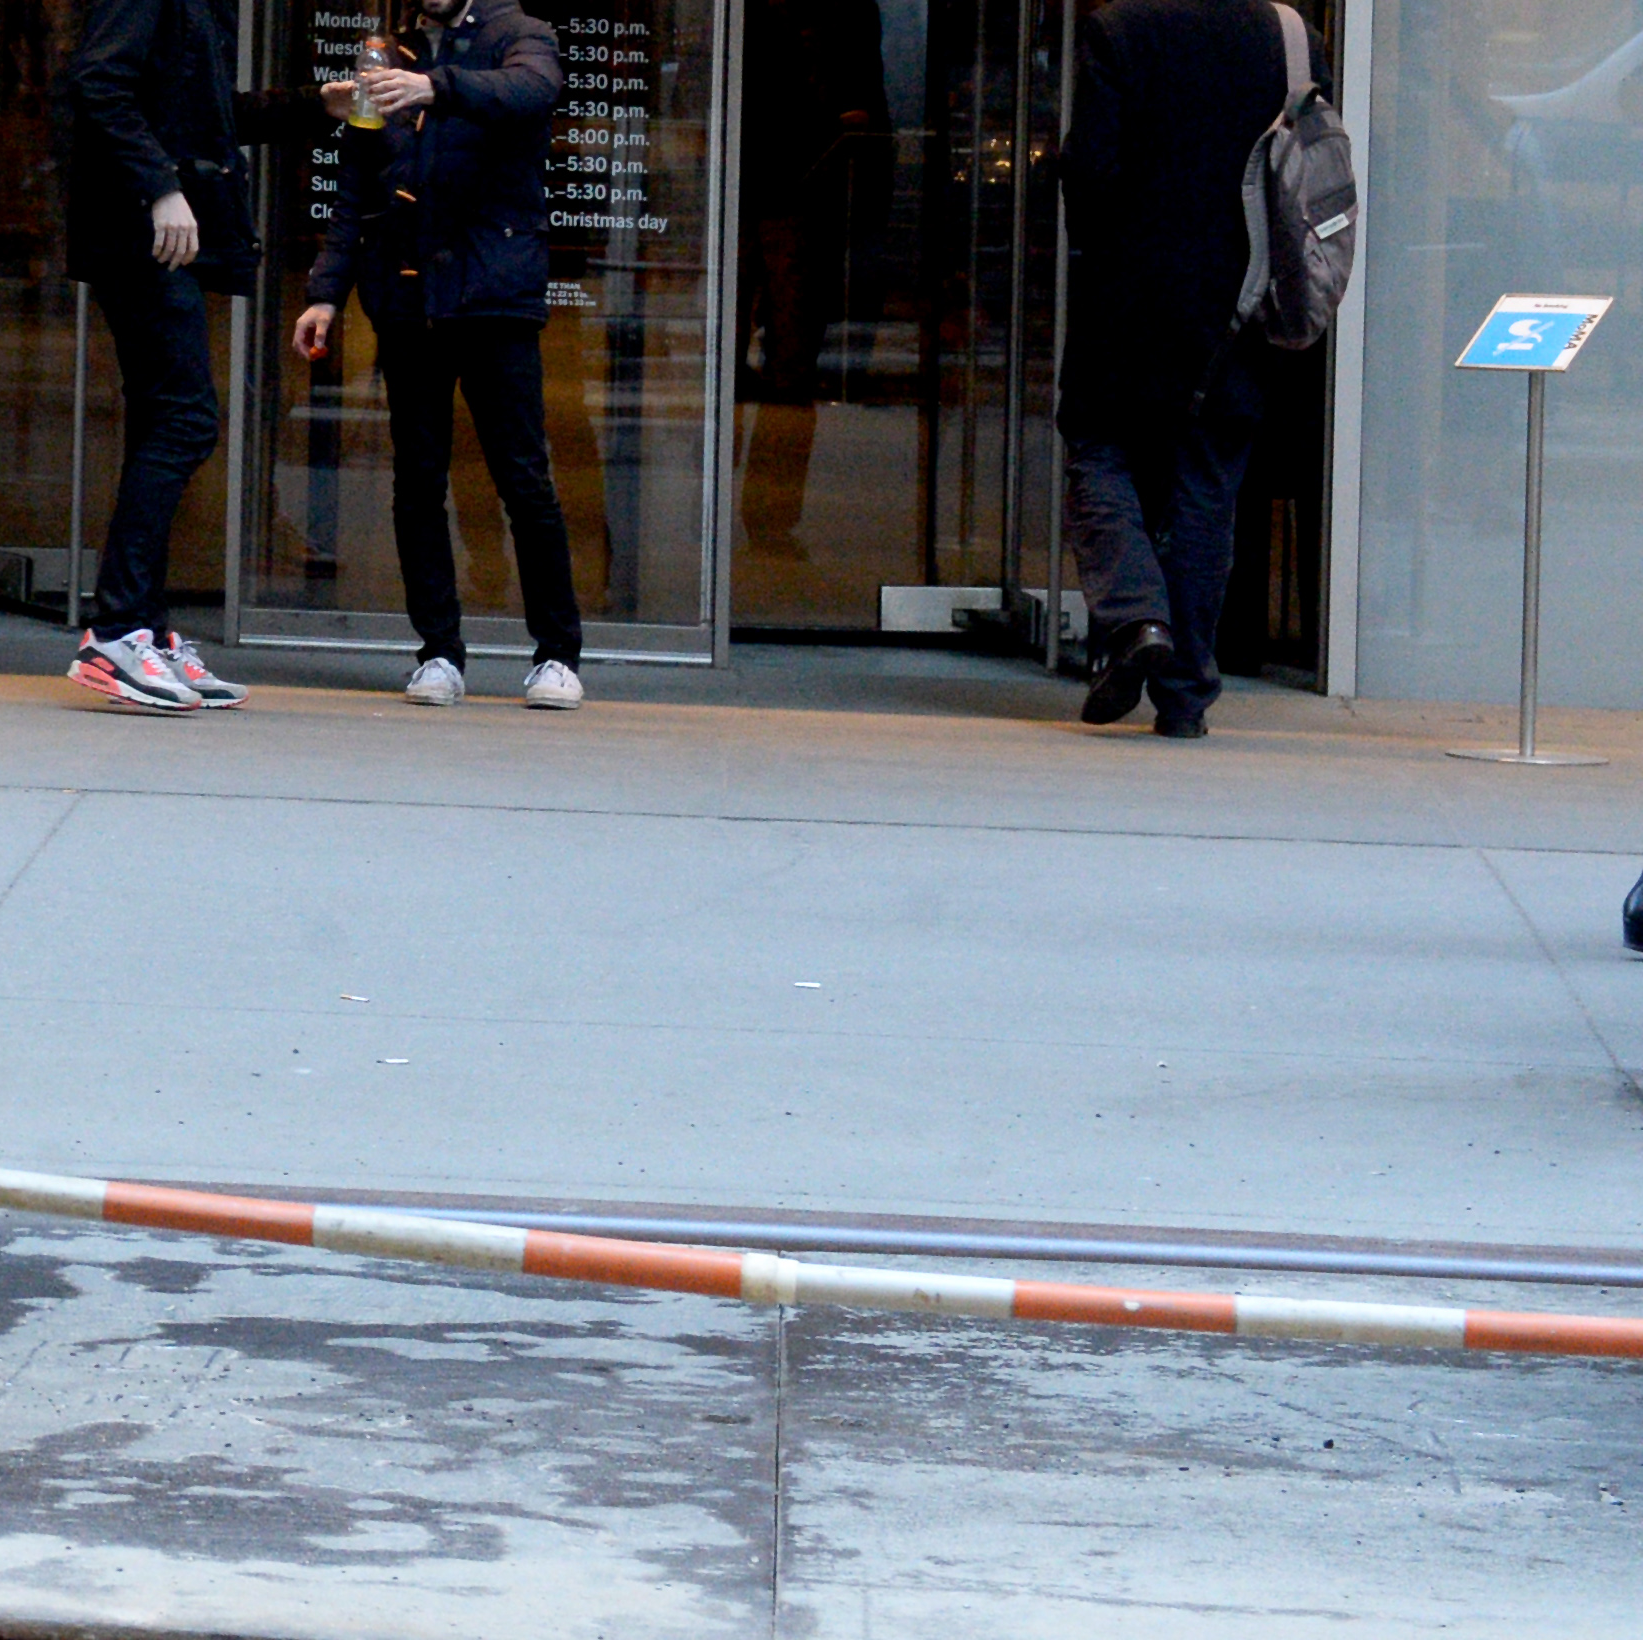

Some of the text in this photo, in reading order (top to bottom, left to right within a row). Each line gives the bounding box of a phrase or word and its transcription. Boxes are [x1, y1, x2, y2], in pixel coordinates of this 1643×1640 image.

[315, 11, 381, 32] Monday
[614, 22, 651, 38] p.m.
[315, 38, 364, 56] Tuesd
[613, 50, 650, 66] p.m.
[612, 77, 649, 93] p.m.
[613, 105, 650, 121] p.m.
[614, 133, 651, 149] p.m.
[612, 160, 648, 176] p.m.
[611, 188, 647, 204] p.m.
[550, 211, 668, 234] Christmas day
[1564, 314, 1598, 349] MoMA
